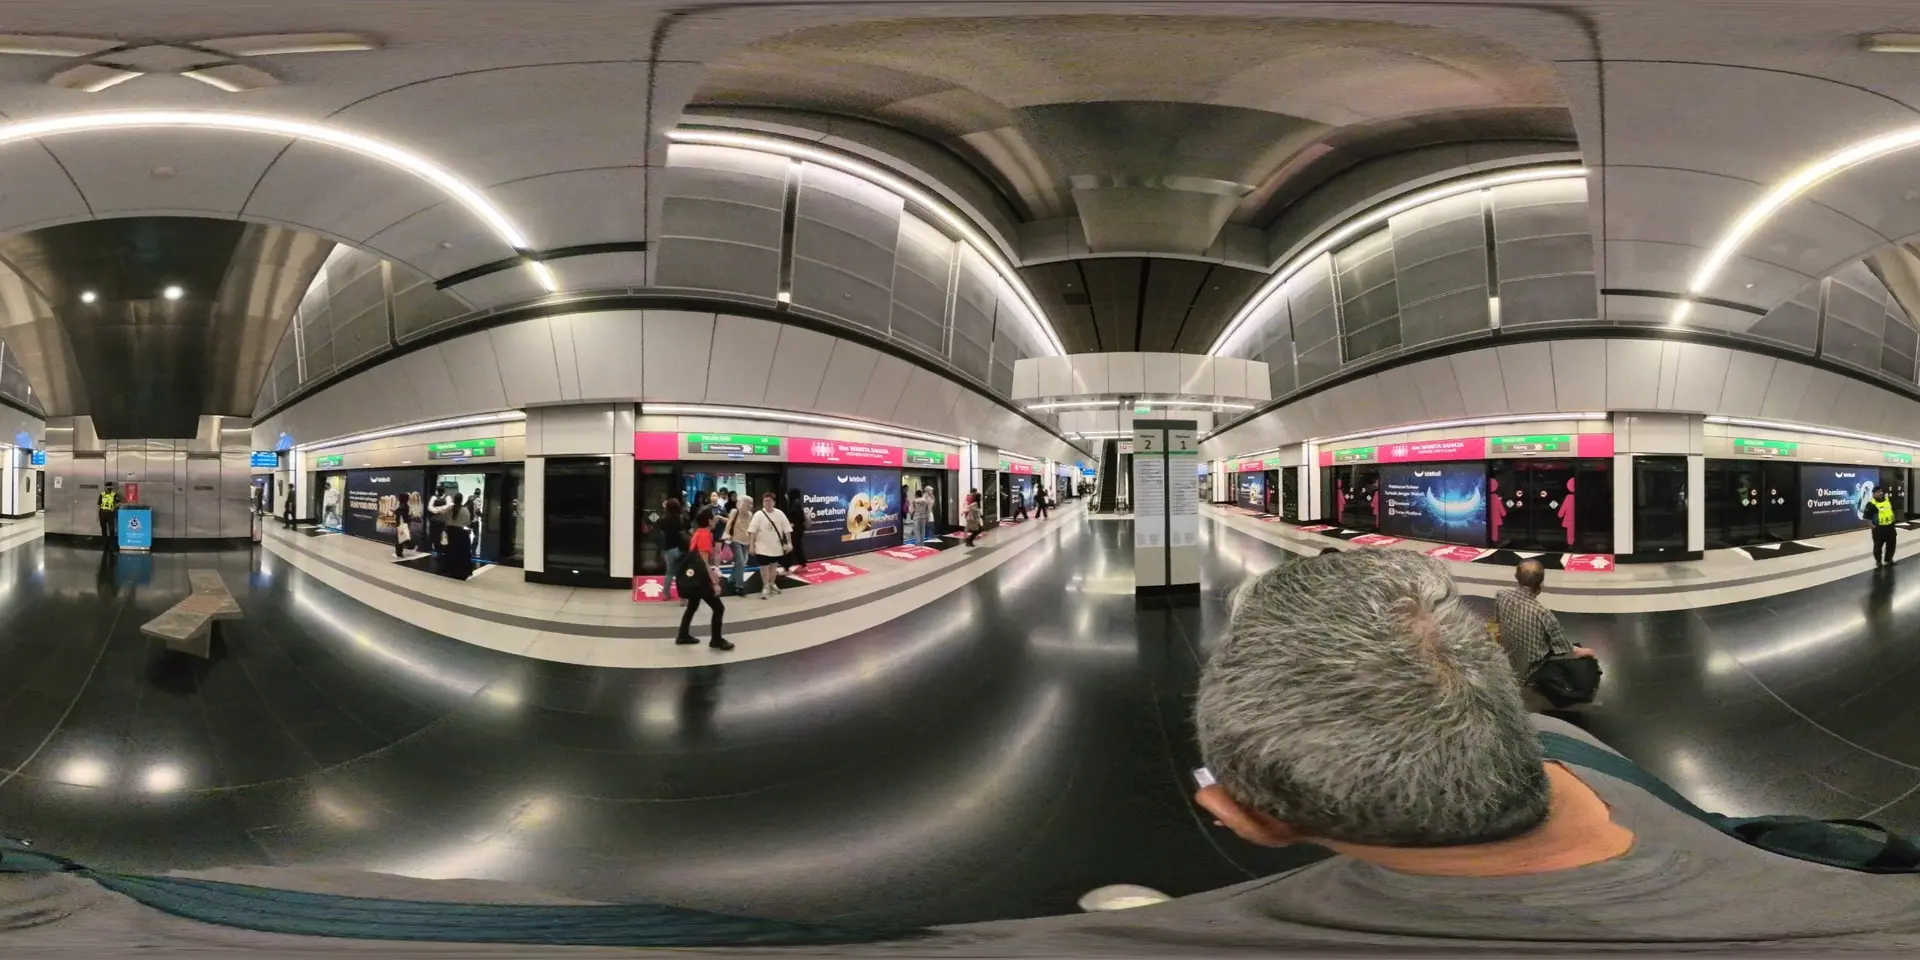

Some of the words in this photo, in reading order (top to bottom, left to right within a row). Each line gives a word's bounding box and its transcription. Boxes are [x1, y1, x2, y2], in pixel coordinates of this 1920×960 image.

[1144, 440, 1151, 449] 2
[1180, 440, 1187, 449] 1
[1824, 488, 1847, 496] Komisen
[803, 495, 839, 504] Pulangan
[1813, 499, 1831, 507] Yuran
[1832, 498, 1855, 506] Platform
[816, 508, 846, 516] setahun
